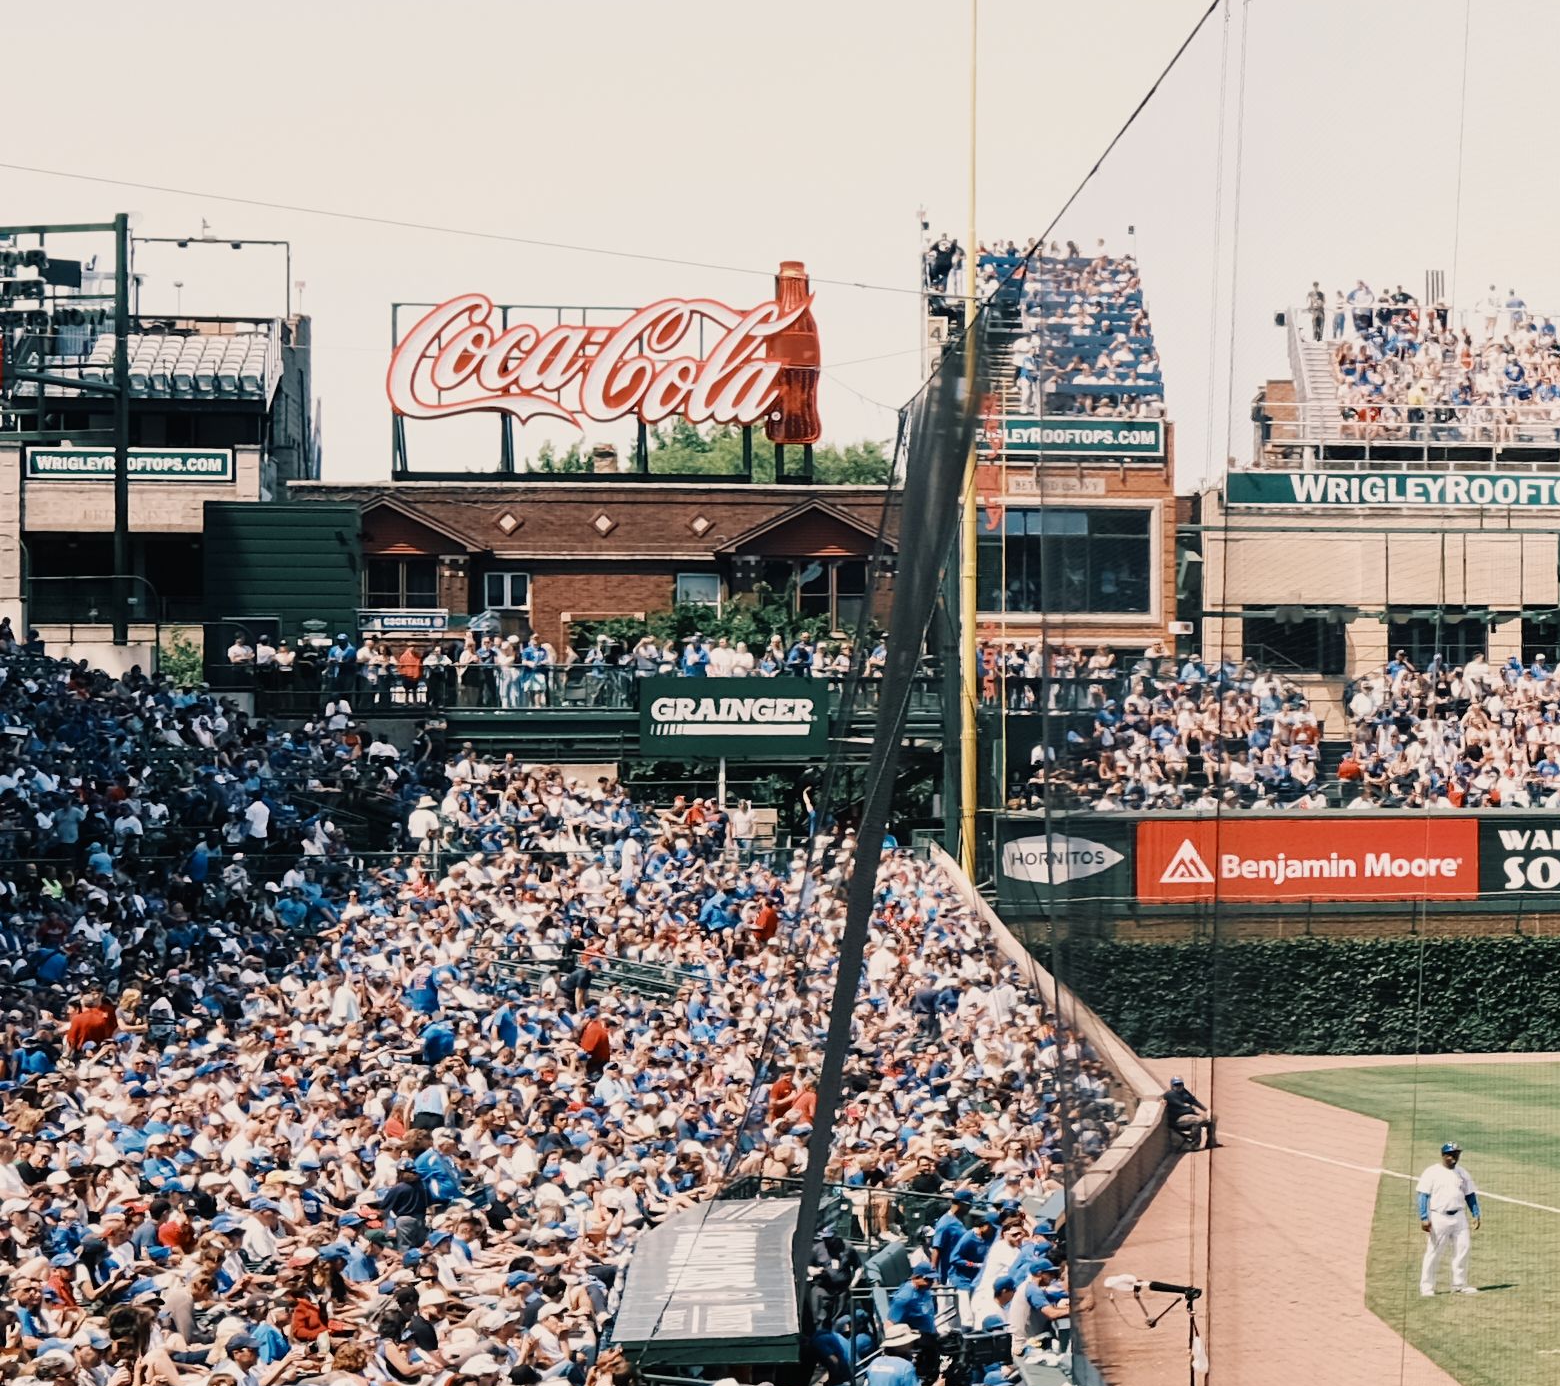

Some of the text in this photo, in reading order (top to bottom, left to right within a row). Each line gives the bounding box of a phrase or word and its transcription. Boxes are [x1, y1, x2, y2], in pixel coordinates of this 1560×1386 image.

[386, 292, 817, 431] Coca-Cola
[36, 455, 222, 472] WRIGLEYROFTOPS.COM
[651, 698, 813, 722] GRAINGER
[1012, 851, 1105, 866] HORNITOS
[1222, 852, 1462, 884] Benjamin Moore
